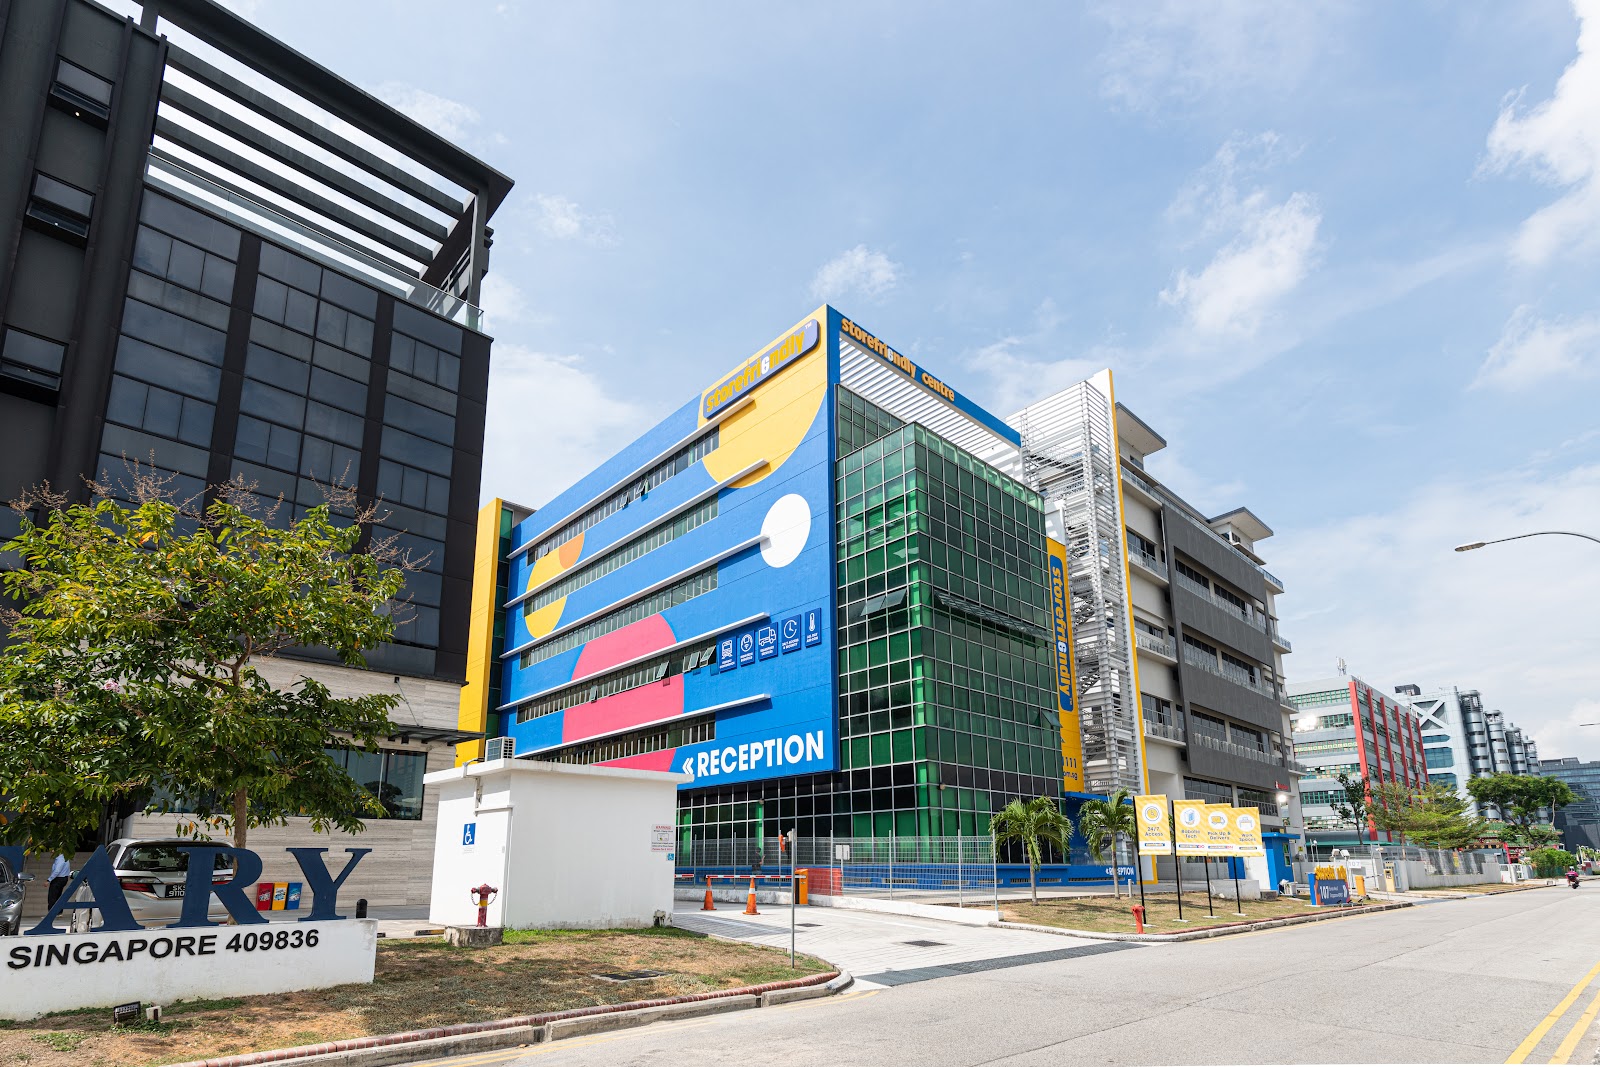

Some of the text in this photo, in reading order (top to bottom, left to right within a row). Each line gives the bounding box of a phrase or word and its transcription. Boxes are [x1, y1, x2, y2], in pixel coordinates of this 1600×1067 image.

[921, 372, 955, 402] centre
[697, 730, 824, 778] RECEPTION
[1062, 756, 1077, 769] 111
[1108, 866, 1135, 876] REEPTION
[0, 844, 373, 936] ARY
[6, 928, 320, 970] SINGAPORE 409836
